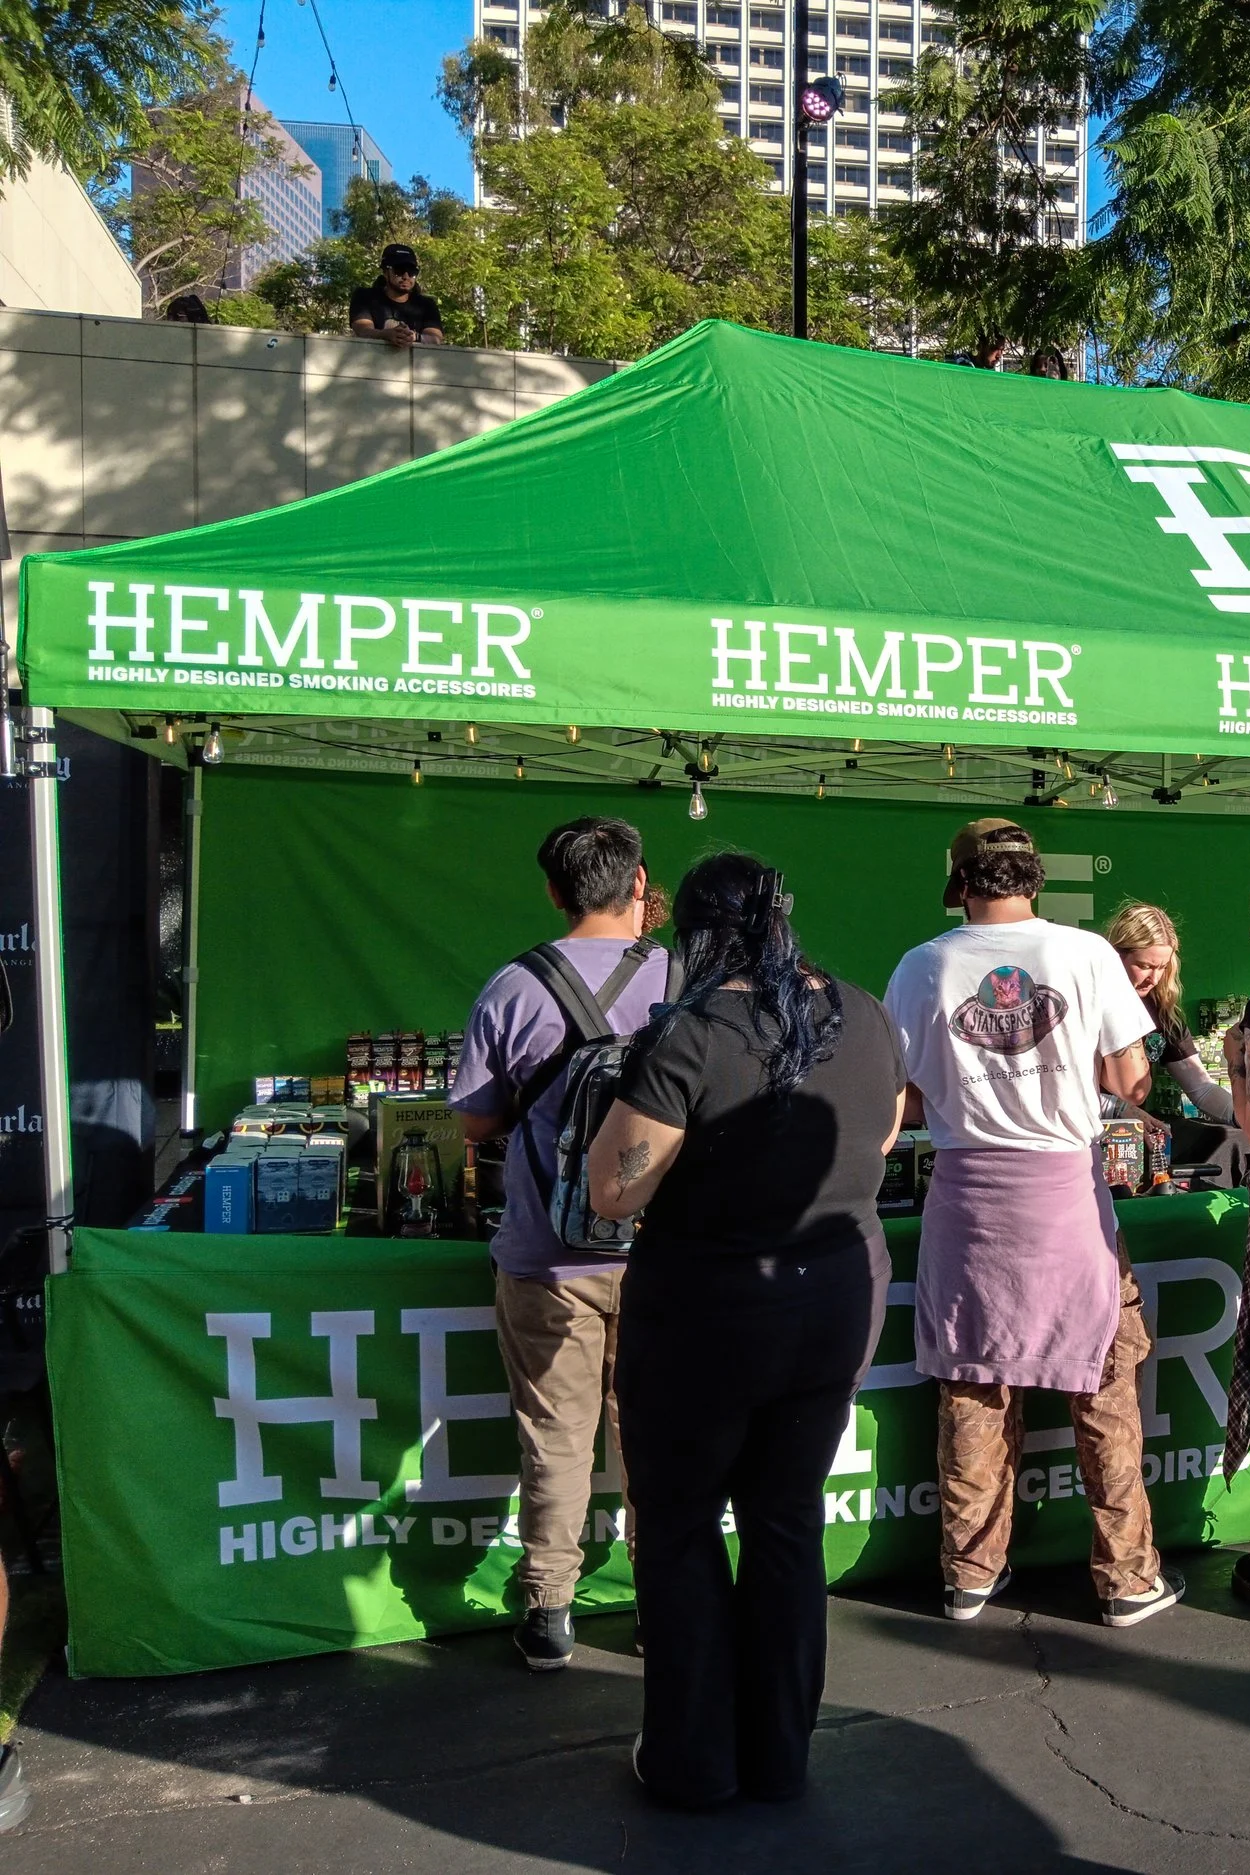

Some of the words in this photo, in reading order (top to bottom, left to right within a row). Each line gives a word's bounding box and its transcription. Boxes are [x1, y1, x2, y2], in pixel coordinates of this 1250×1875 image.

[88, 666, 170, 684] HIGHLY
[174, 669, 284, 691] DESIGNED
[288, 673, 389, 694] SMOKING
[393, 678, 537, 699] ACCESSOIRES
[712, 693, 779, 711] HIGHLY
[782, 696, 874, 715] DESIGNED
[876, 701, 959, 721] SMOKING
[962, 705, 1078, 726] ACCESSOIRES
[395, 1109, 453, 1122] HEMPER
[222, 1185, 232, 1224] HEMPER
[219, 1512, 412, 1566] HIGHLY
